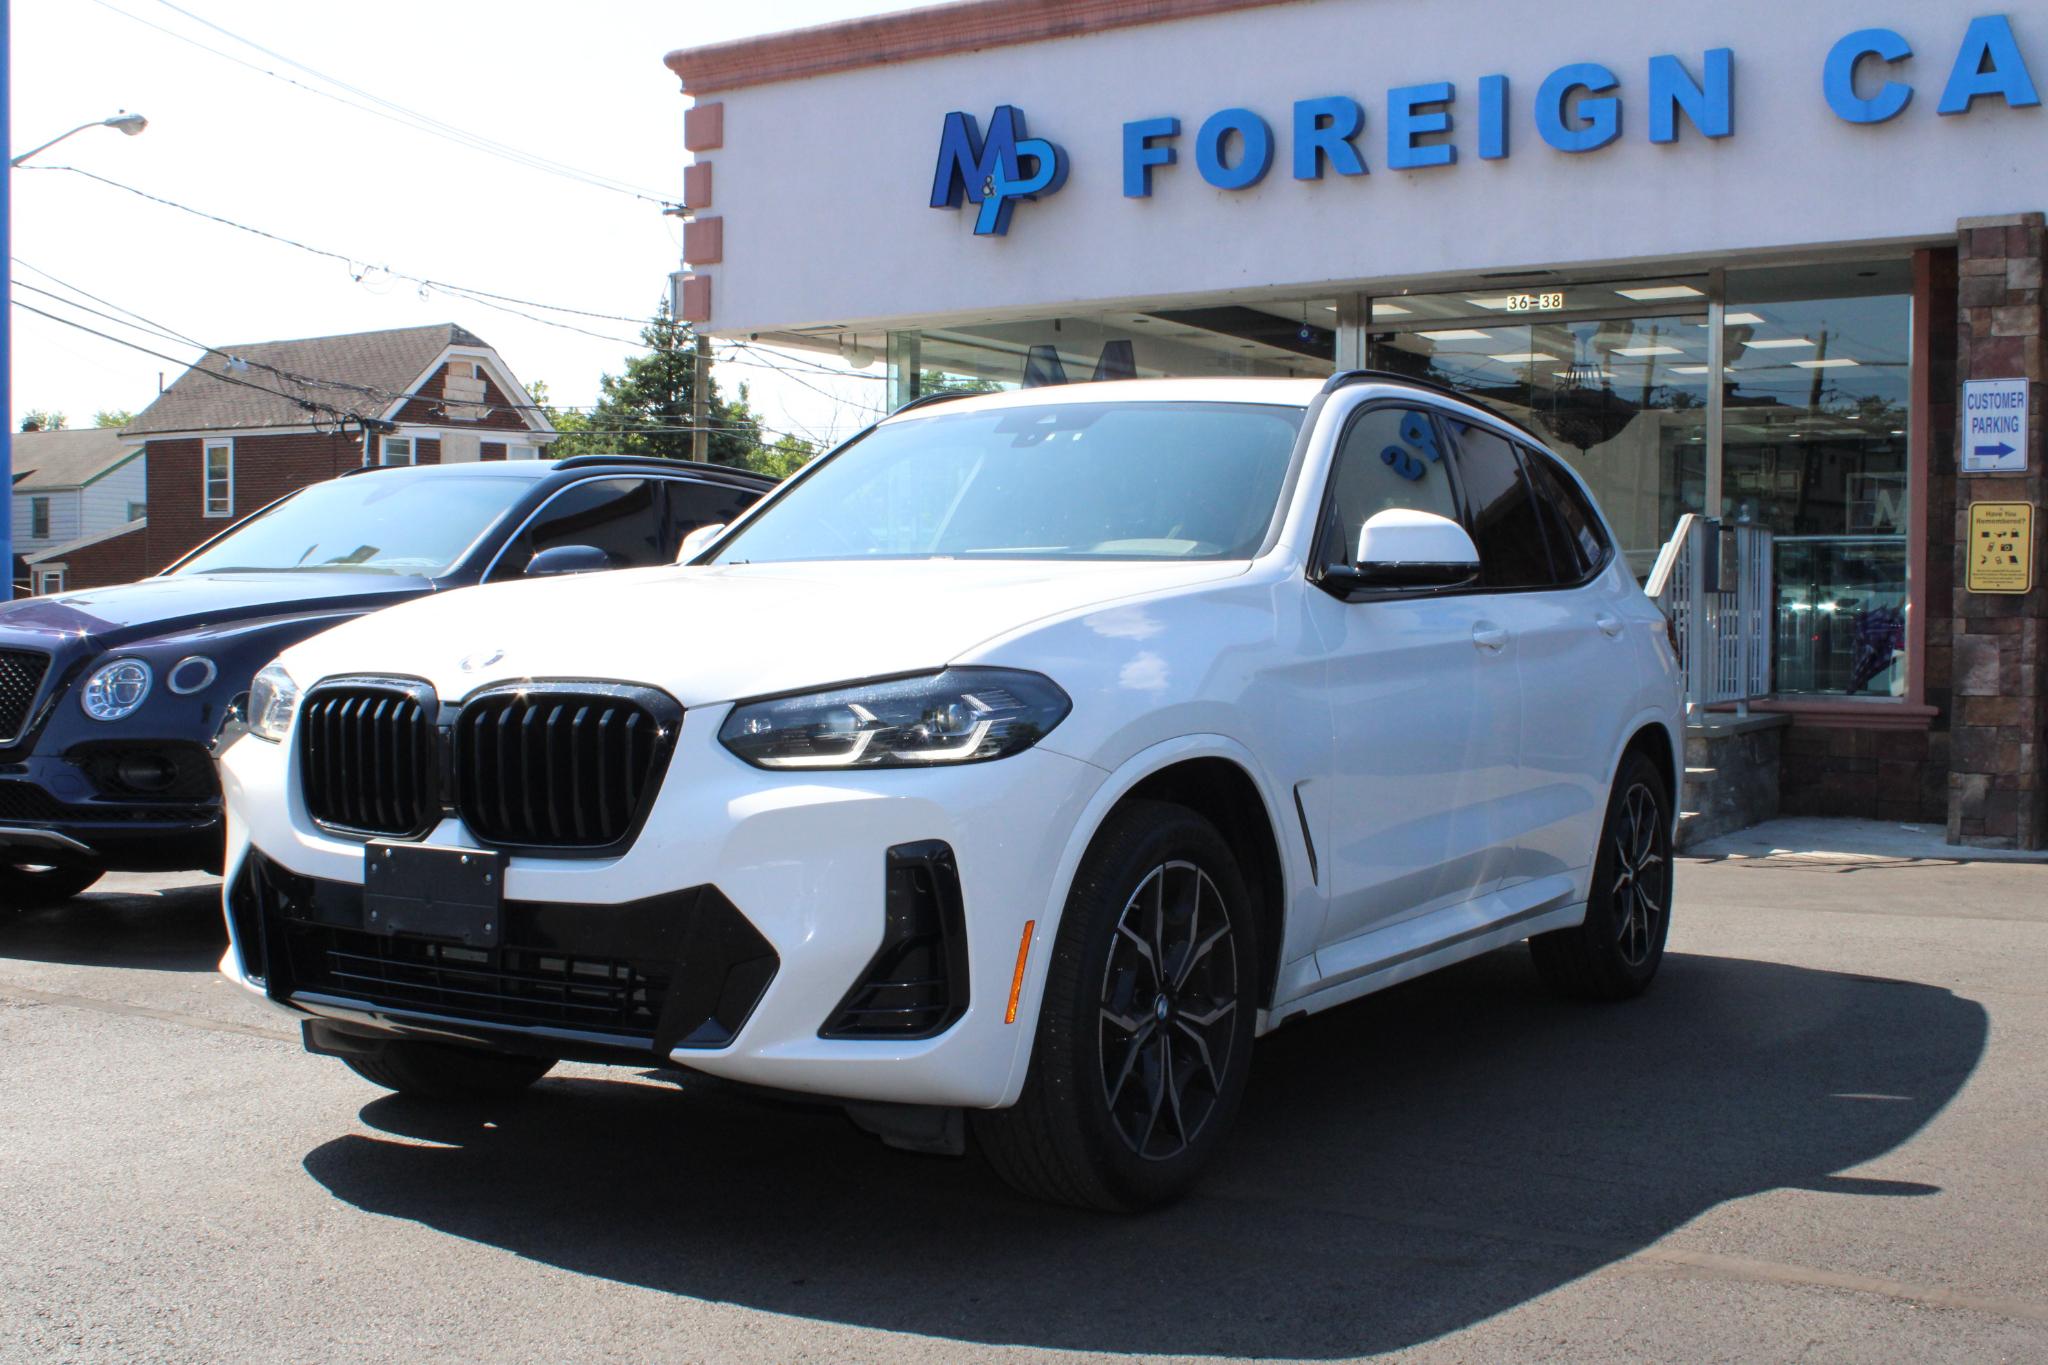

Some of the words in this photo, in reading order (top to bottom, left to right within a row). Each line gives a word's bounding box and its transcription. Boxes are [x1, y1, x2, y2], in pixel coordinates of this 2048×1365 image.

[1123, 48, 1734, 198] FOREIGN
[1824, 14, 2041, 124] CA
[1507, 293, 1562, 310] 36-38
[1967, 392, 2025, 410] CUSTOMER
[1971, 415, 2019, 433] PARKING
